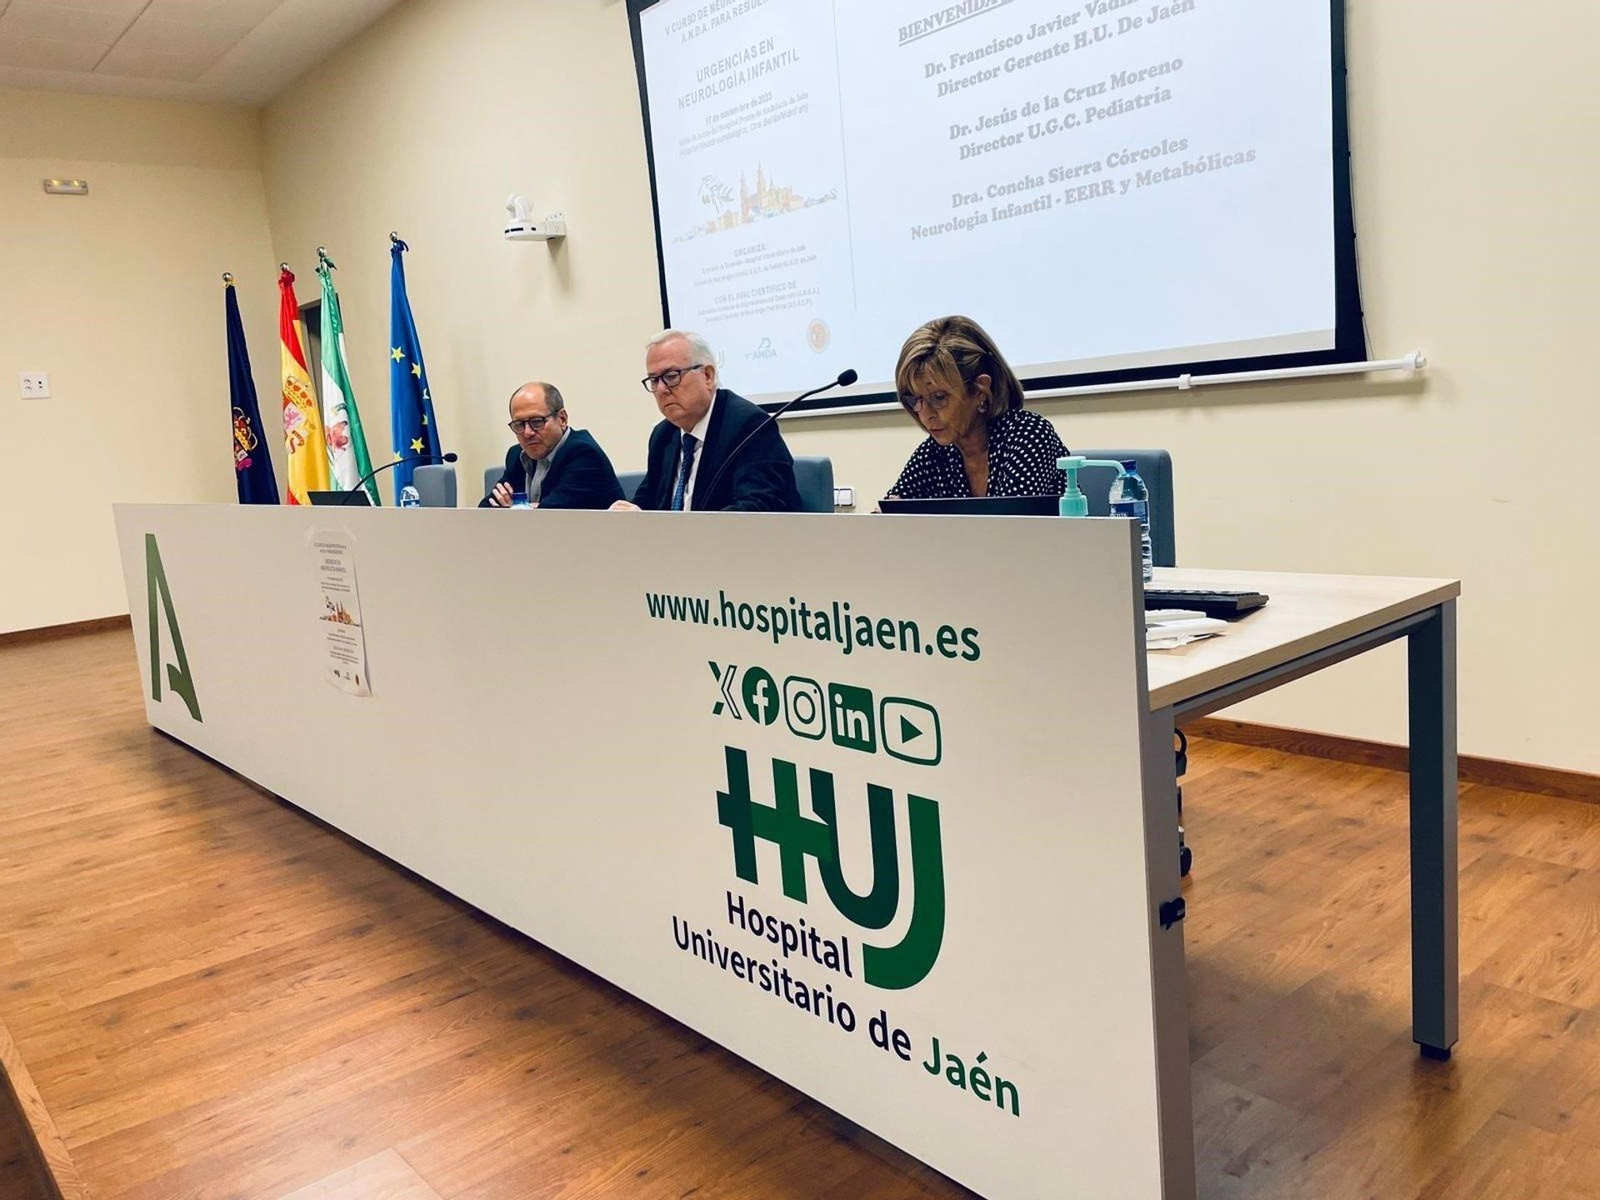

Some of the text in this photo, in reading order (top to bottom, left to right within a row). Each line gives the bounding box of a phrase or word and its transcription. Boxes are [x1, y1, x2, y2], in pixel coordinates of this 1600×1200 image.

[671, 12, 697, 33] CURSO
[697, 6, 709, 20] DE
[711, 10, 732, 29] PARA
[923, 62, 946, 79] Dr.
[949, 34, 1023, 69] Francisco
[1026, 10, 1080, 42] Javier
[678, 47, 800, 110] NEUROLOGÍA INFANTIL
[696, 36, 775, 82] URGENCIAS EN
[936, 65, 1001, 98] Director
[1004, 41, 1070, 73] Gerente
[1073, 23, 1114, 51] H.U.
[1117, 15, 1143, 35] De
[949, 57, 1184, 140] Dr. Jesús de la Cruz Moreno
[959, 86, 1172, 160] Director U.G.C. Pediatría
[910, 210, 988, 240] Neurología
[991, 194, 1053, 222] Infantil
[1064, 177, 1116, 204] EERR
[1119, 177, 1131, 195] y
[1134, 147, 1256, 188] Metabólicas
[951, 136, 1189, 209] Dra. Concha Sierra Córcoles
[645, 590, 981, 662] www.hospitaljaen.es
[726, 890, 853, 978] Hospital
[672, 914, 1020, 1117] Universitario de Jaén
